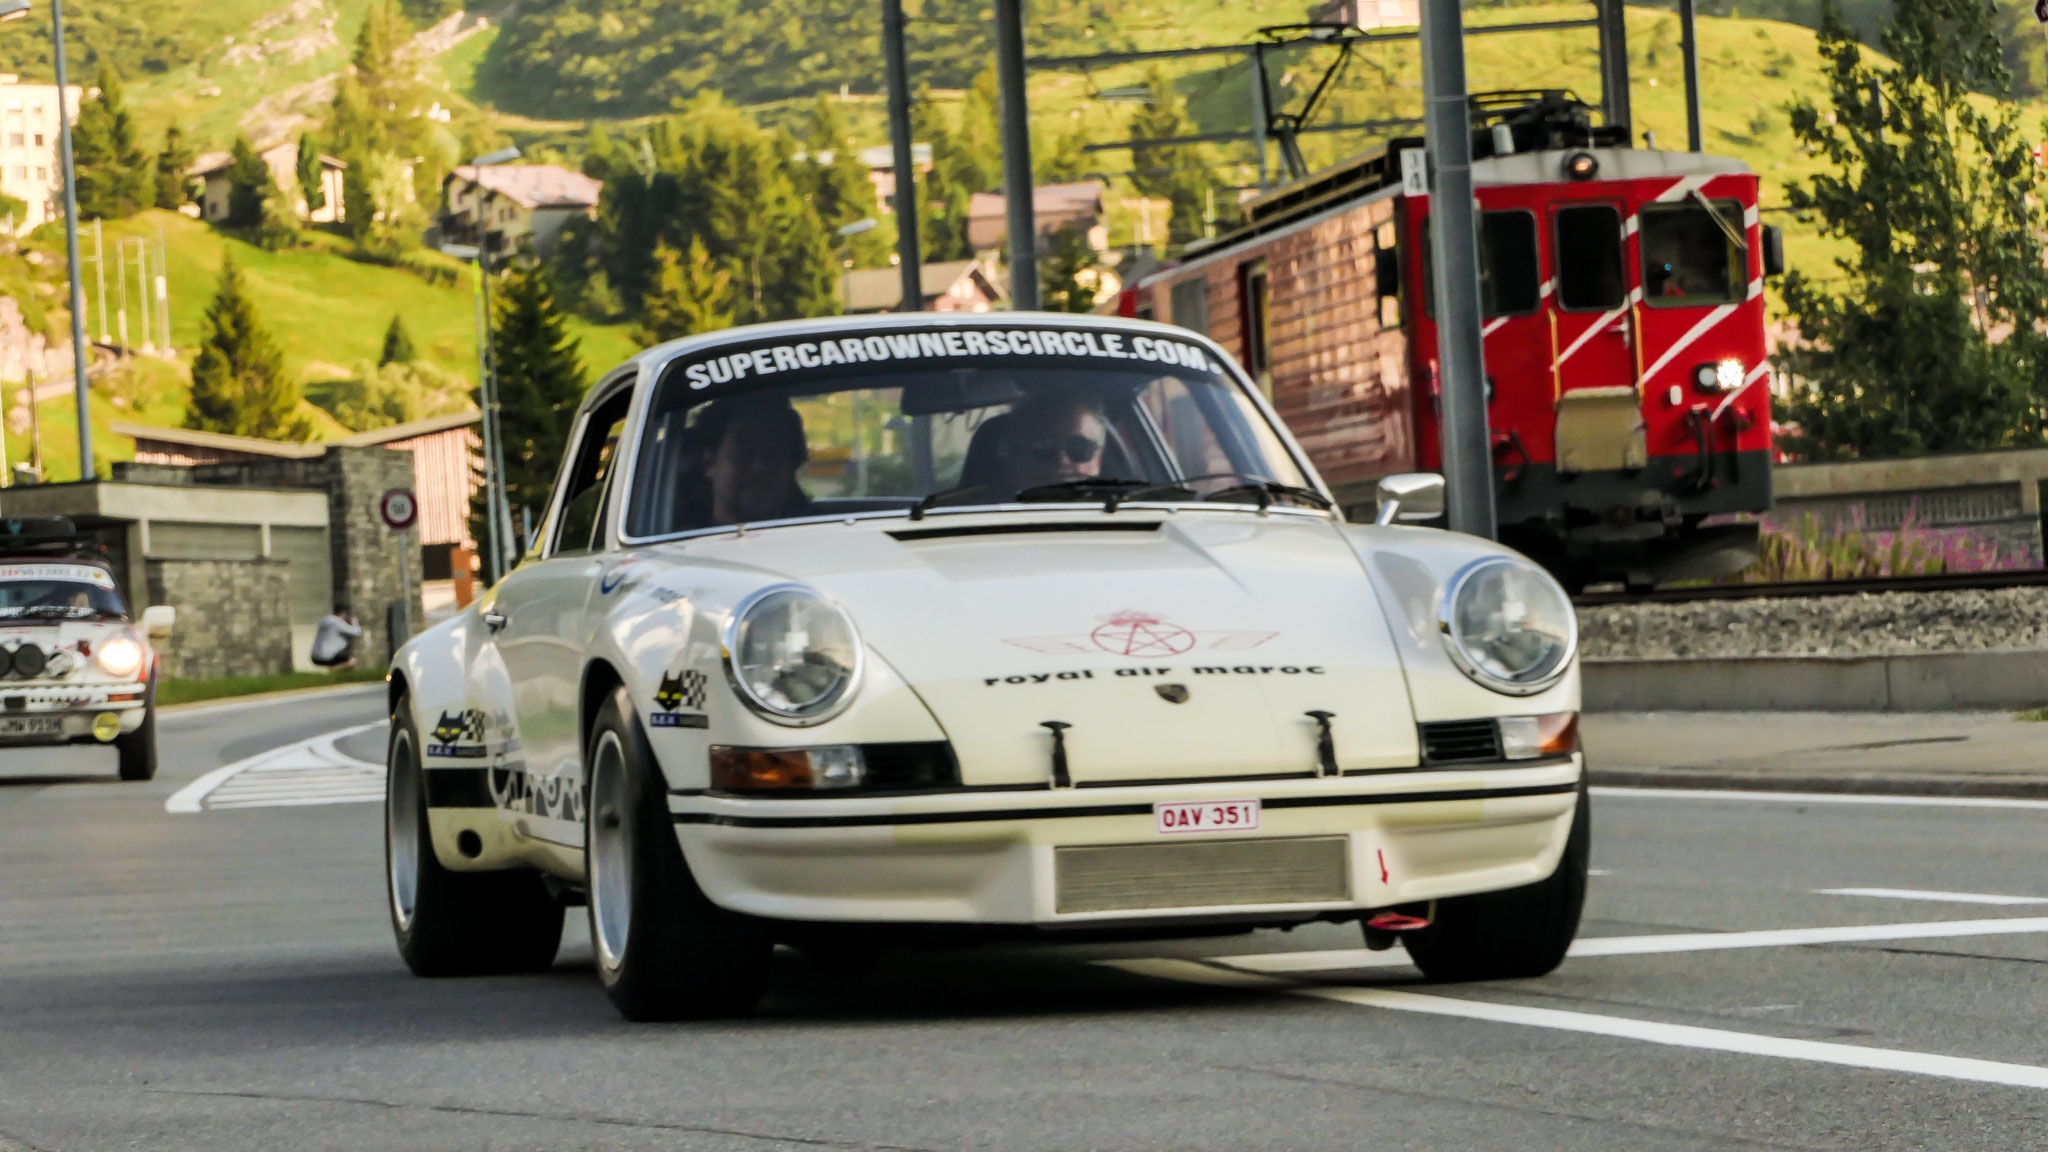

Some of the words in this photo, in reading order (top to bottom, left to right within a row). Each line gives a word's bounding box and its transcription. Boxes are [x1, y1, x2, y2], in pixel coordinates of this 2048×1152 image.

[984, 670, 1095, 686] royal
[1114, 666, 1171, 677] air
[1192, 664, 1326, 675] maroc
[1164, 808, 1203, 827] OAV
[1212, 806, 1250, 826] 351
